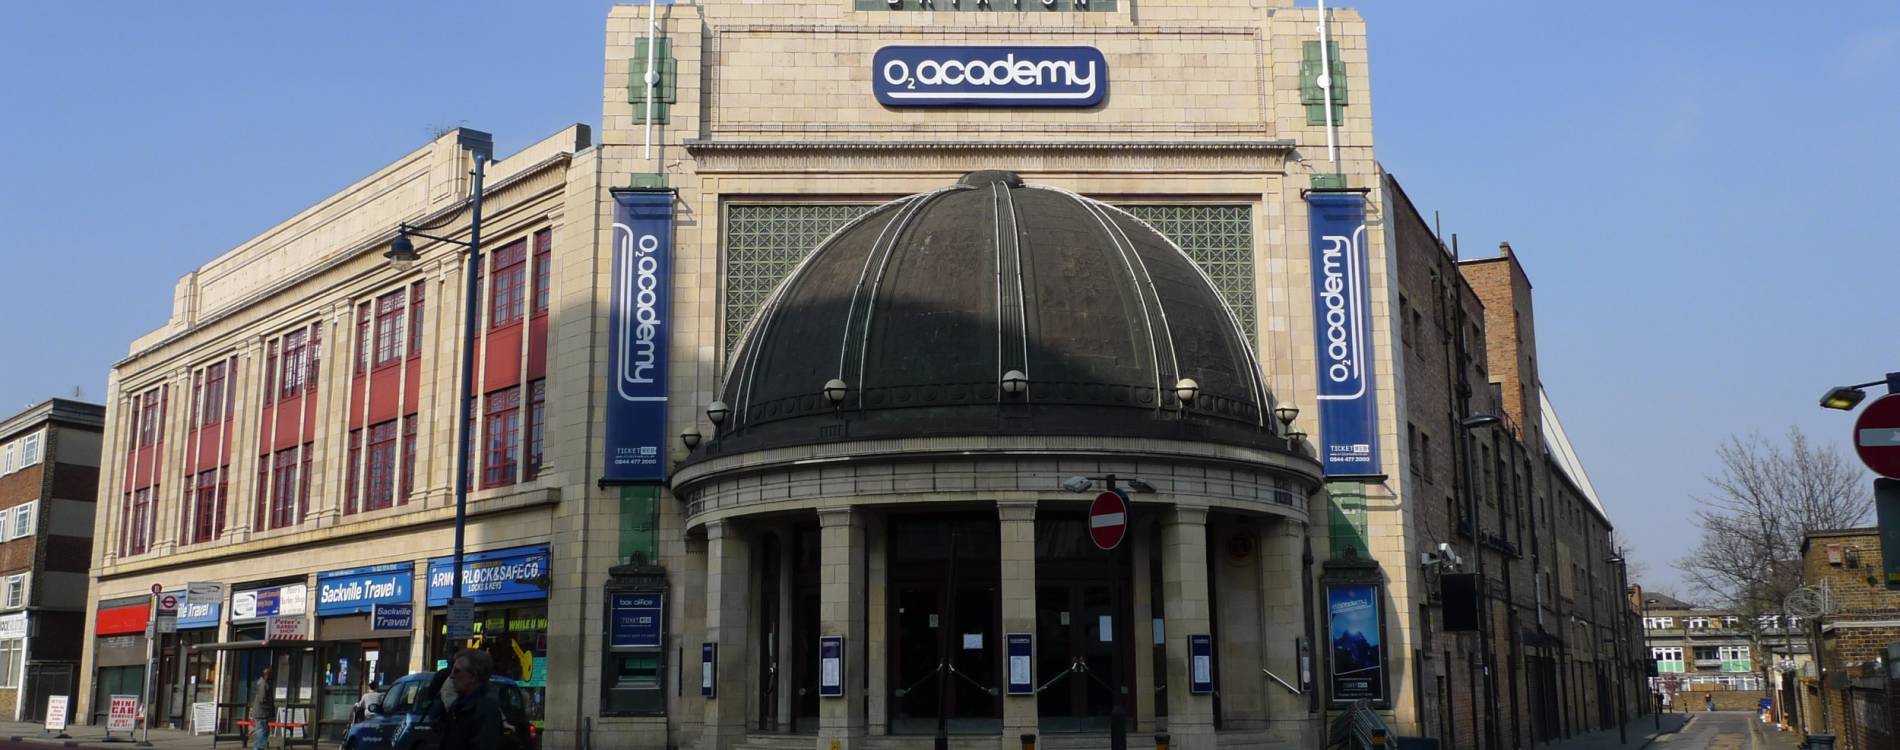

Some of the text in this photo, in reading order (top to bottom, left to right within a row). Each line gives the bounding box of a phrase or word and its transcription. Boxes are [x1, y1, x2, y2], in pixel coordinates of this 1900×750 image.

[321, 577, 396, 603] Sackville Travel
[188, 603, 209, 617] Travel
[376, 607, 411, 616] Sackville
[376, 617, 410, 627] Travel
[112, 706, 134, 714] CAB
